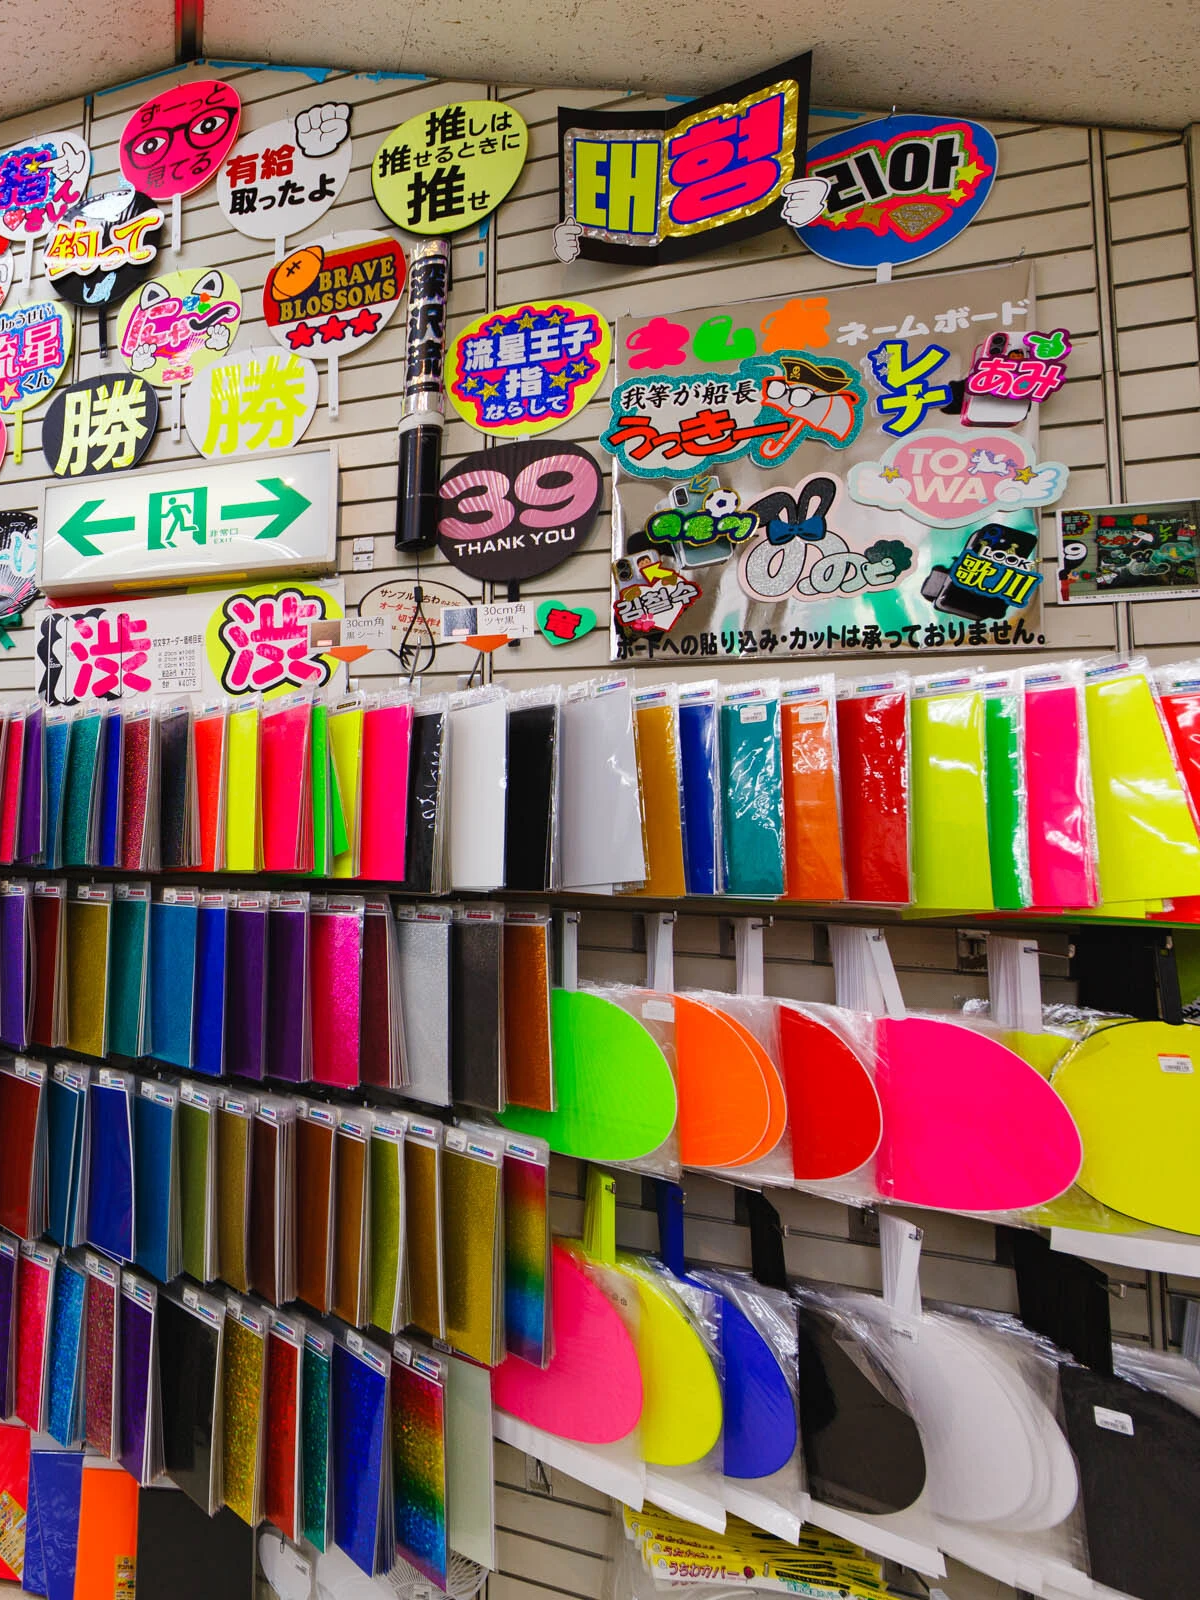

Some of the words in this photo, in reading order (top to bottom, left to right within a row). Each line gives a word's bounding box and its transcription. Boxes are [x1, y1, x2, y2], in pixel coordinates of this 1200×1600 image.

[426, 105, 513, 147] 推しは
[147, 152, 212, 190] 見てる
[226, 144, 296, 188] 有給
[378, 134, 521, 178] 推せるときに
[574, 93, 785, 235] 태형
[815, 136, 959, 214] 리아
[229, 173, 337, 214] 取ったよ
[407, 165, 491, 226] 推せ
[49, 214, 160, 277] 釣って
[318, 255, 396, 292] BRAVE
[279, 280, 396, 323] BLOSSOMS
[837, 299, 1031, 346] ネームボード
[464, 321, 594, 372] 流星王子
[22, 372, 52, 392] くん
[505, 366, 545, 400] 指
[622, 380, 759, 411] 我等が船長
[882, 344, 947, 433] レナ
[969, 357, 1061, 399] あみ
[205, 353, 313, 457] 勝
[485, 395, 567, 421] ならして
[54, 379, 149, 477] 勝
[608, 409, 789, 460] うっきー
[908, 447, 969, 476] TO
[439, 454, 598, 540] 39
[913, 476, 988, 504] WA
[209, 527, 239, 538] 非常口
[454, 536, 526, 557] THANK
[529, 527, 576, 545] YOU
[955, 553, 1038, 605] 歌川
[978, 545, 1033, 571] LOOK
[346, 616, 384, 628] 30cm角
[484, 604, 527, 616] 30cm角
[617, 581, 698, 623] 김철수
[70, 612, 152, 697] 渋
[227, 596, 322, 686] 渋
